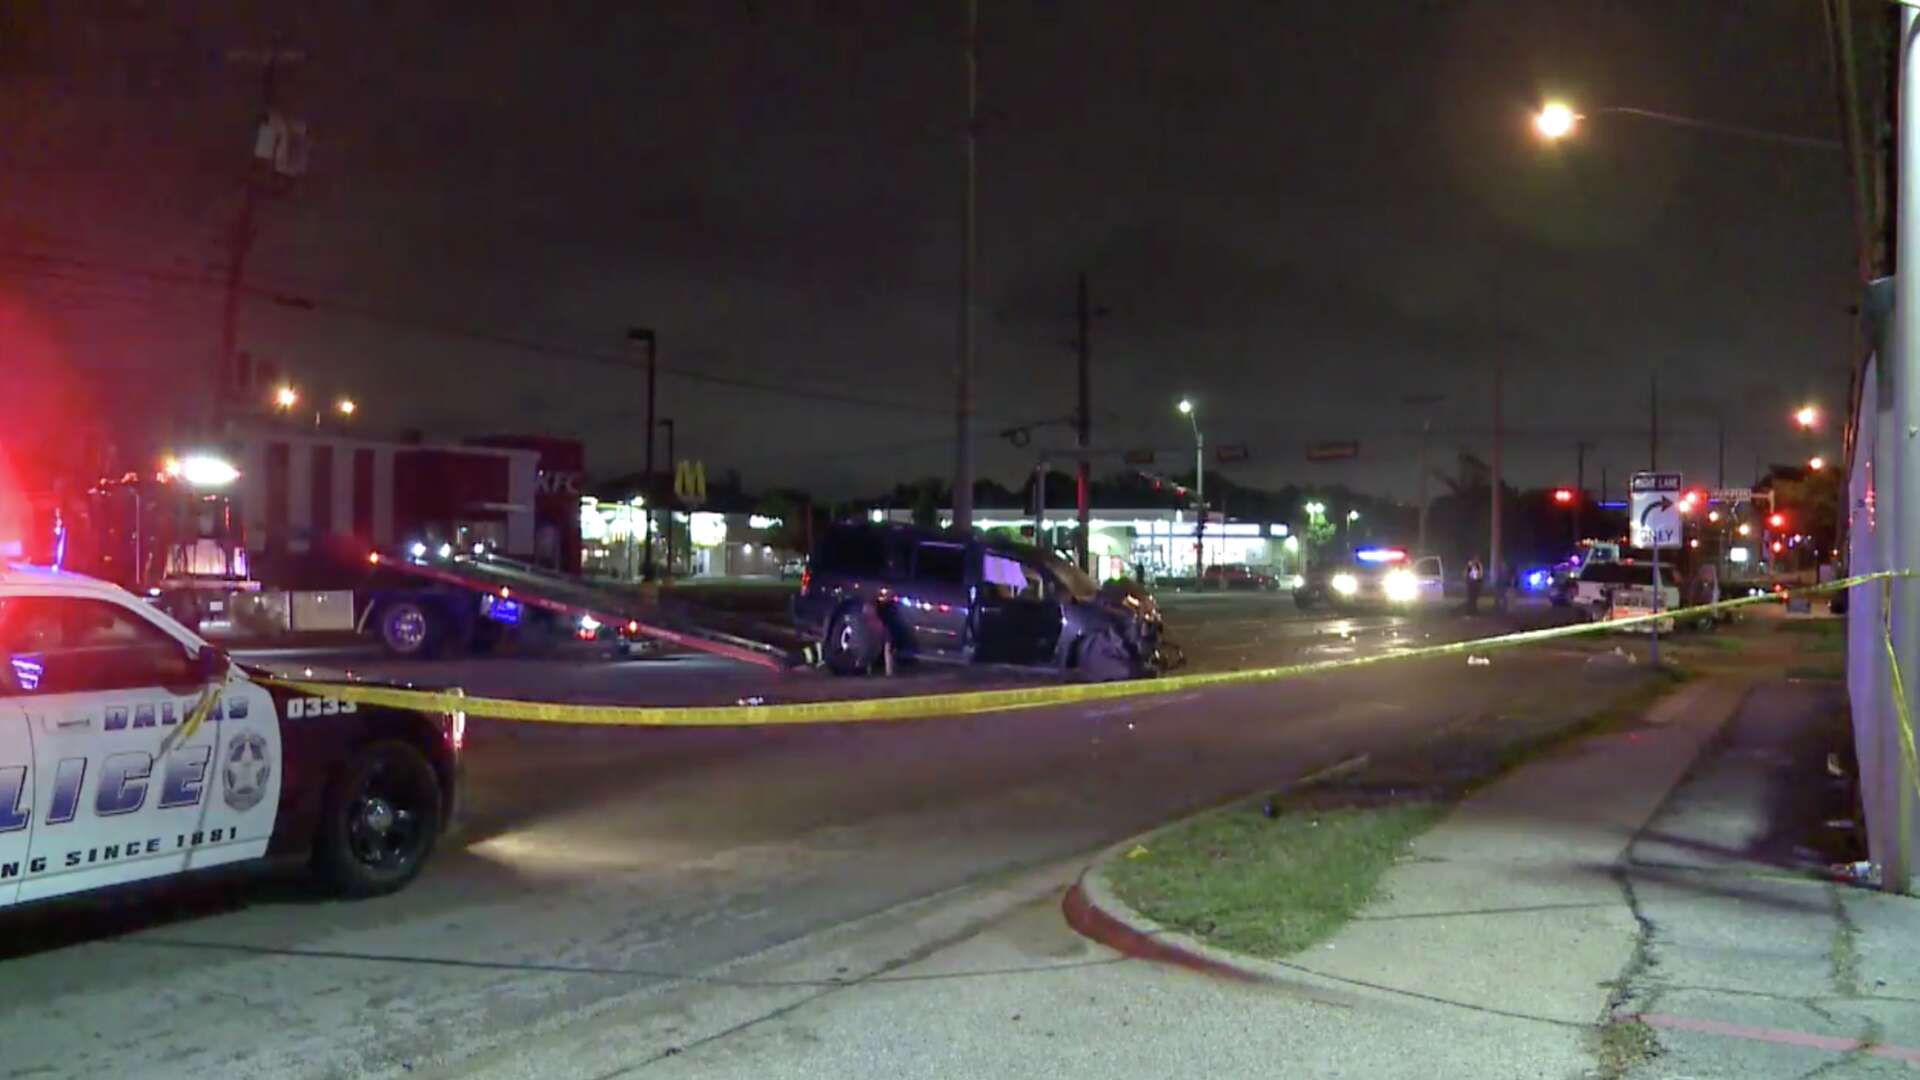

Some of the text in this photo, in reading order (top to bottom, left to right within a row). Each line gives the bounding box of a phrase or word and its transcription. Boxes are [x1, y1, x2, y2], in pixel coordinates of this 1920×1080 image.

[538, 470, 579, 494] KFC
[1641, 529, 1673, 541] ONLY
[65, 838, 161, 866] SINCE
[177, 827, 237, 848] 1881
